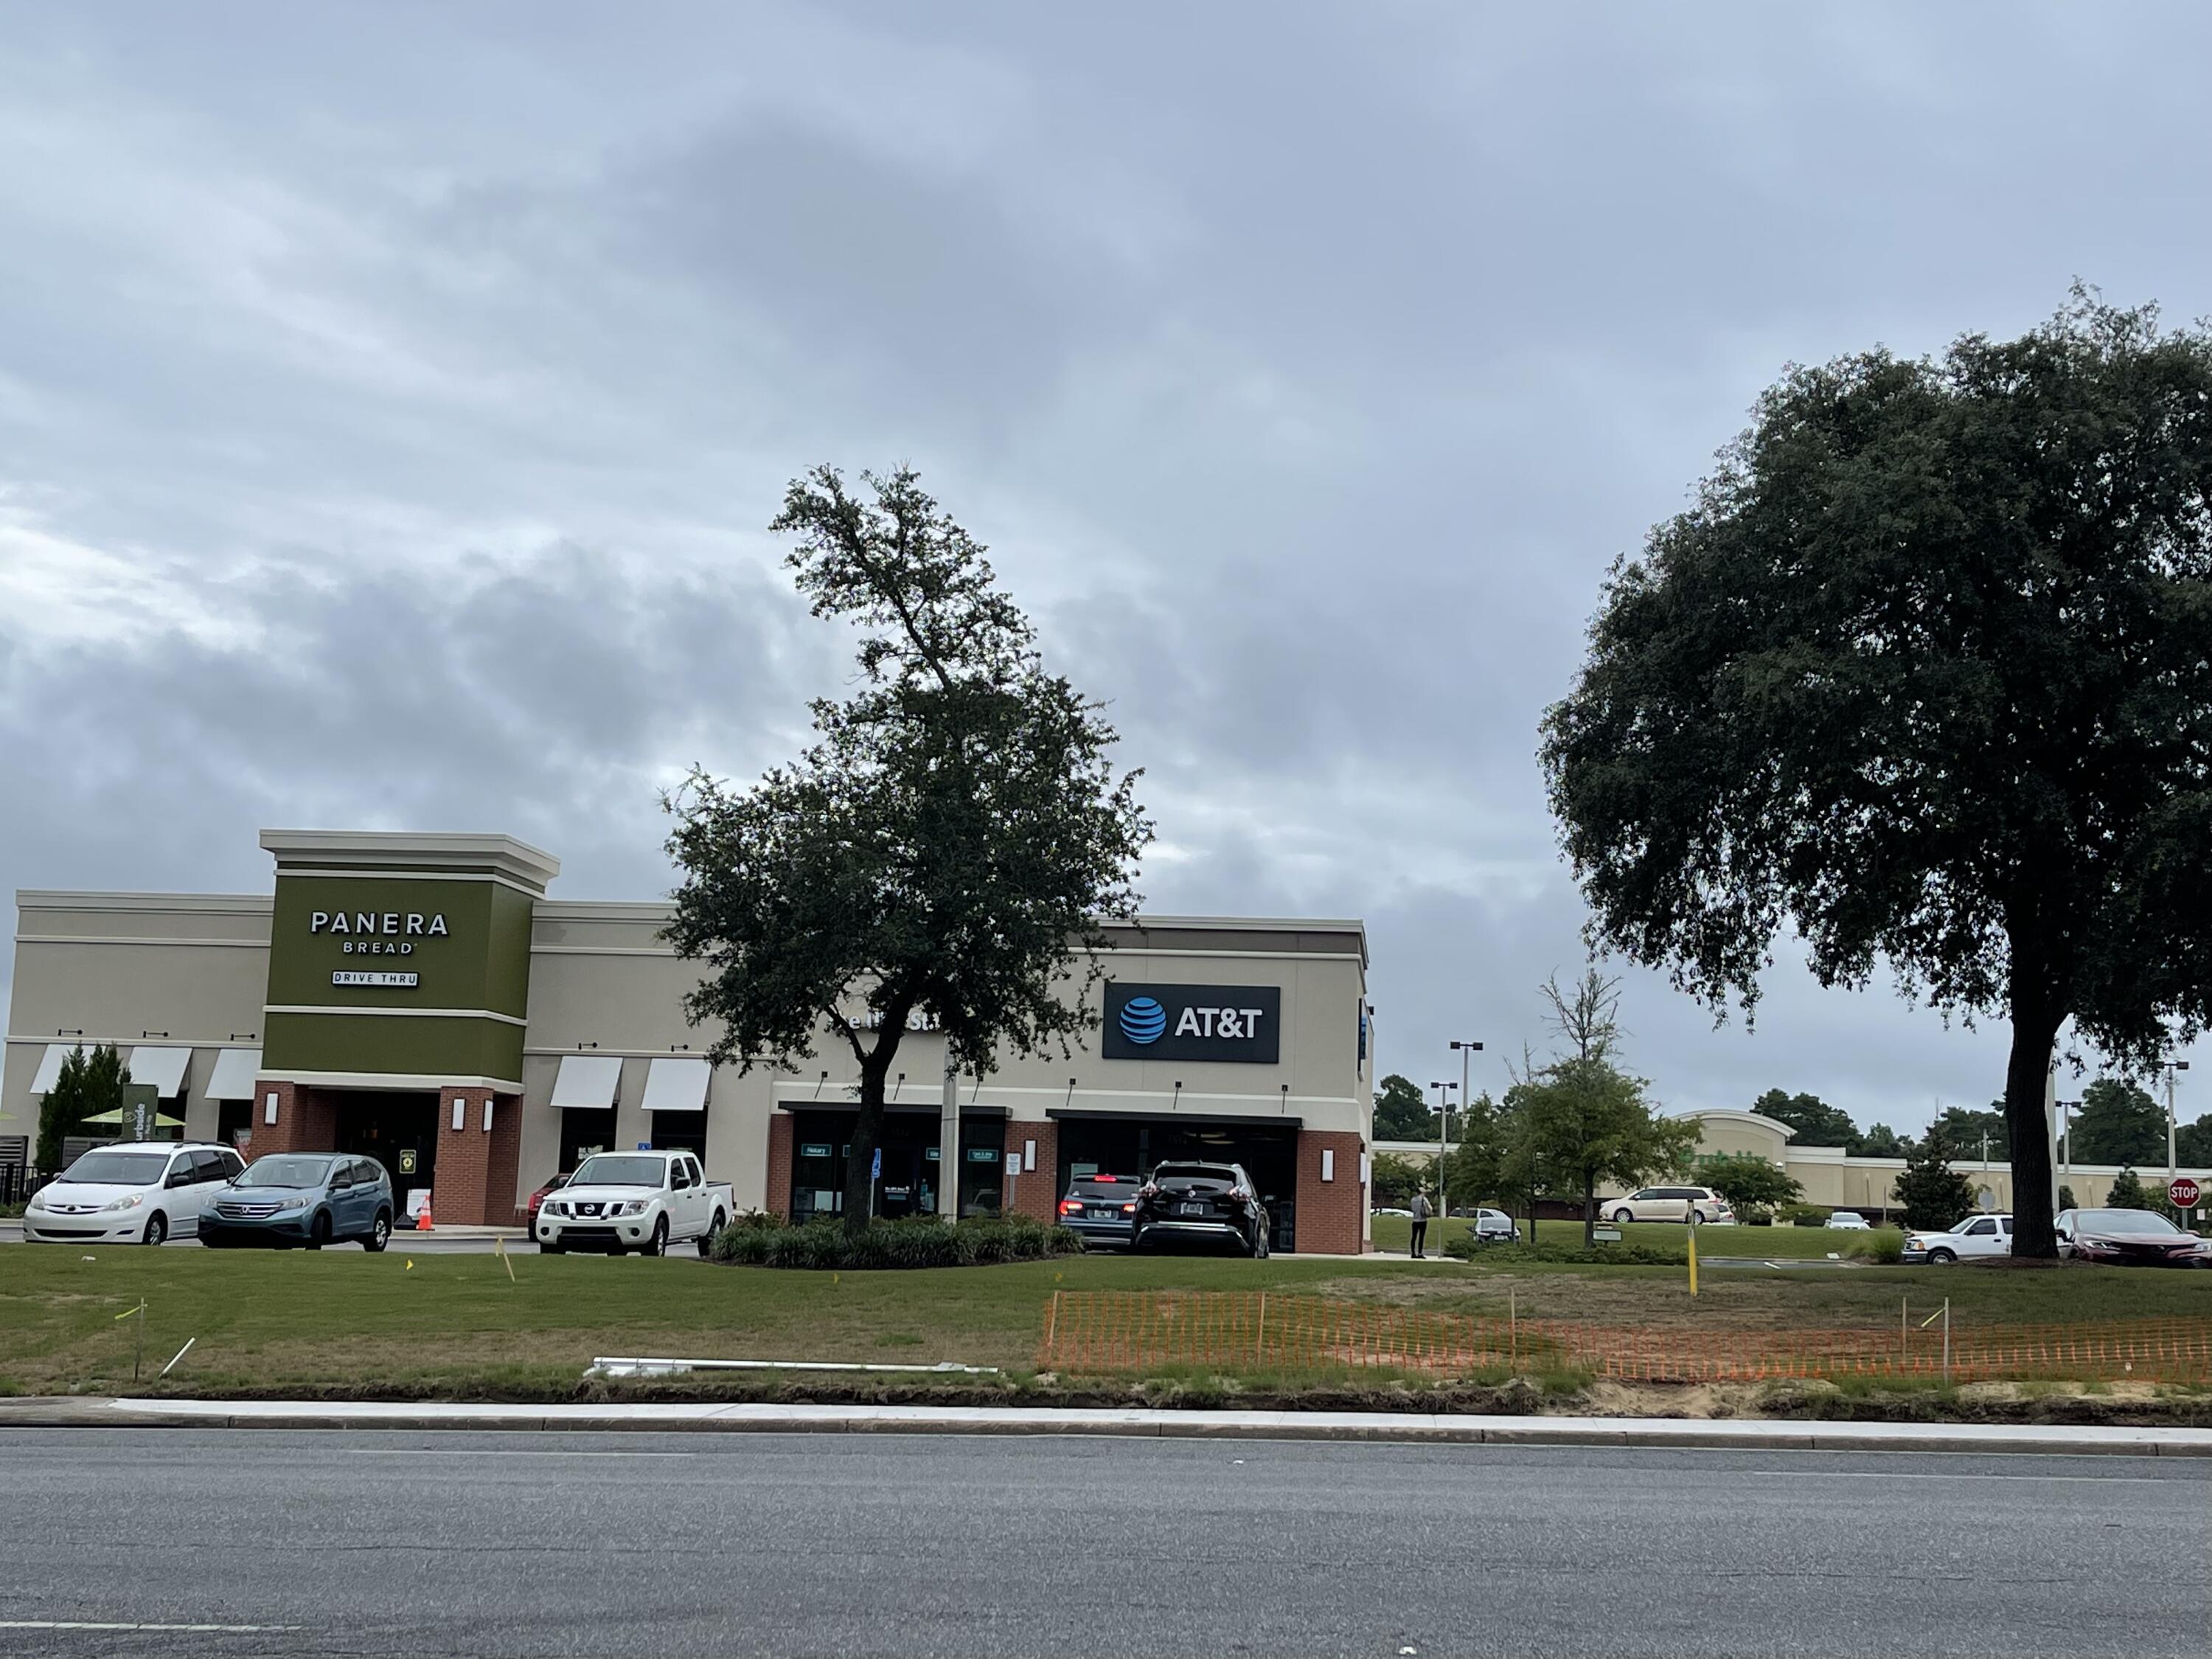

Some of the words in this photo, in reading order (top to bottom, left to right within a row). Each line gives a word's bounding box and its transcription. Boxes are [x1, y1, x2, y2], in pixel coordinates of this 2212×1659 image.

[310, 911, 449, 935] PANERA
[343, 941, 412, 954] BREAD
[334, 973, 374, 983] DRIVE
[381, 974, 417, 984] THRU
[1174, 1006, 1263, 1039] AT&T
[133, 1103, 145, 1141] urbside
[2171, 1186, 2198, 1198] STOP
